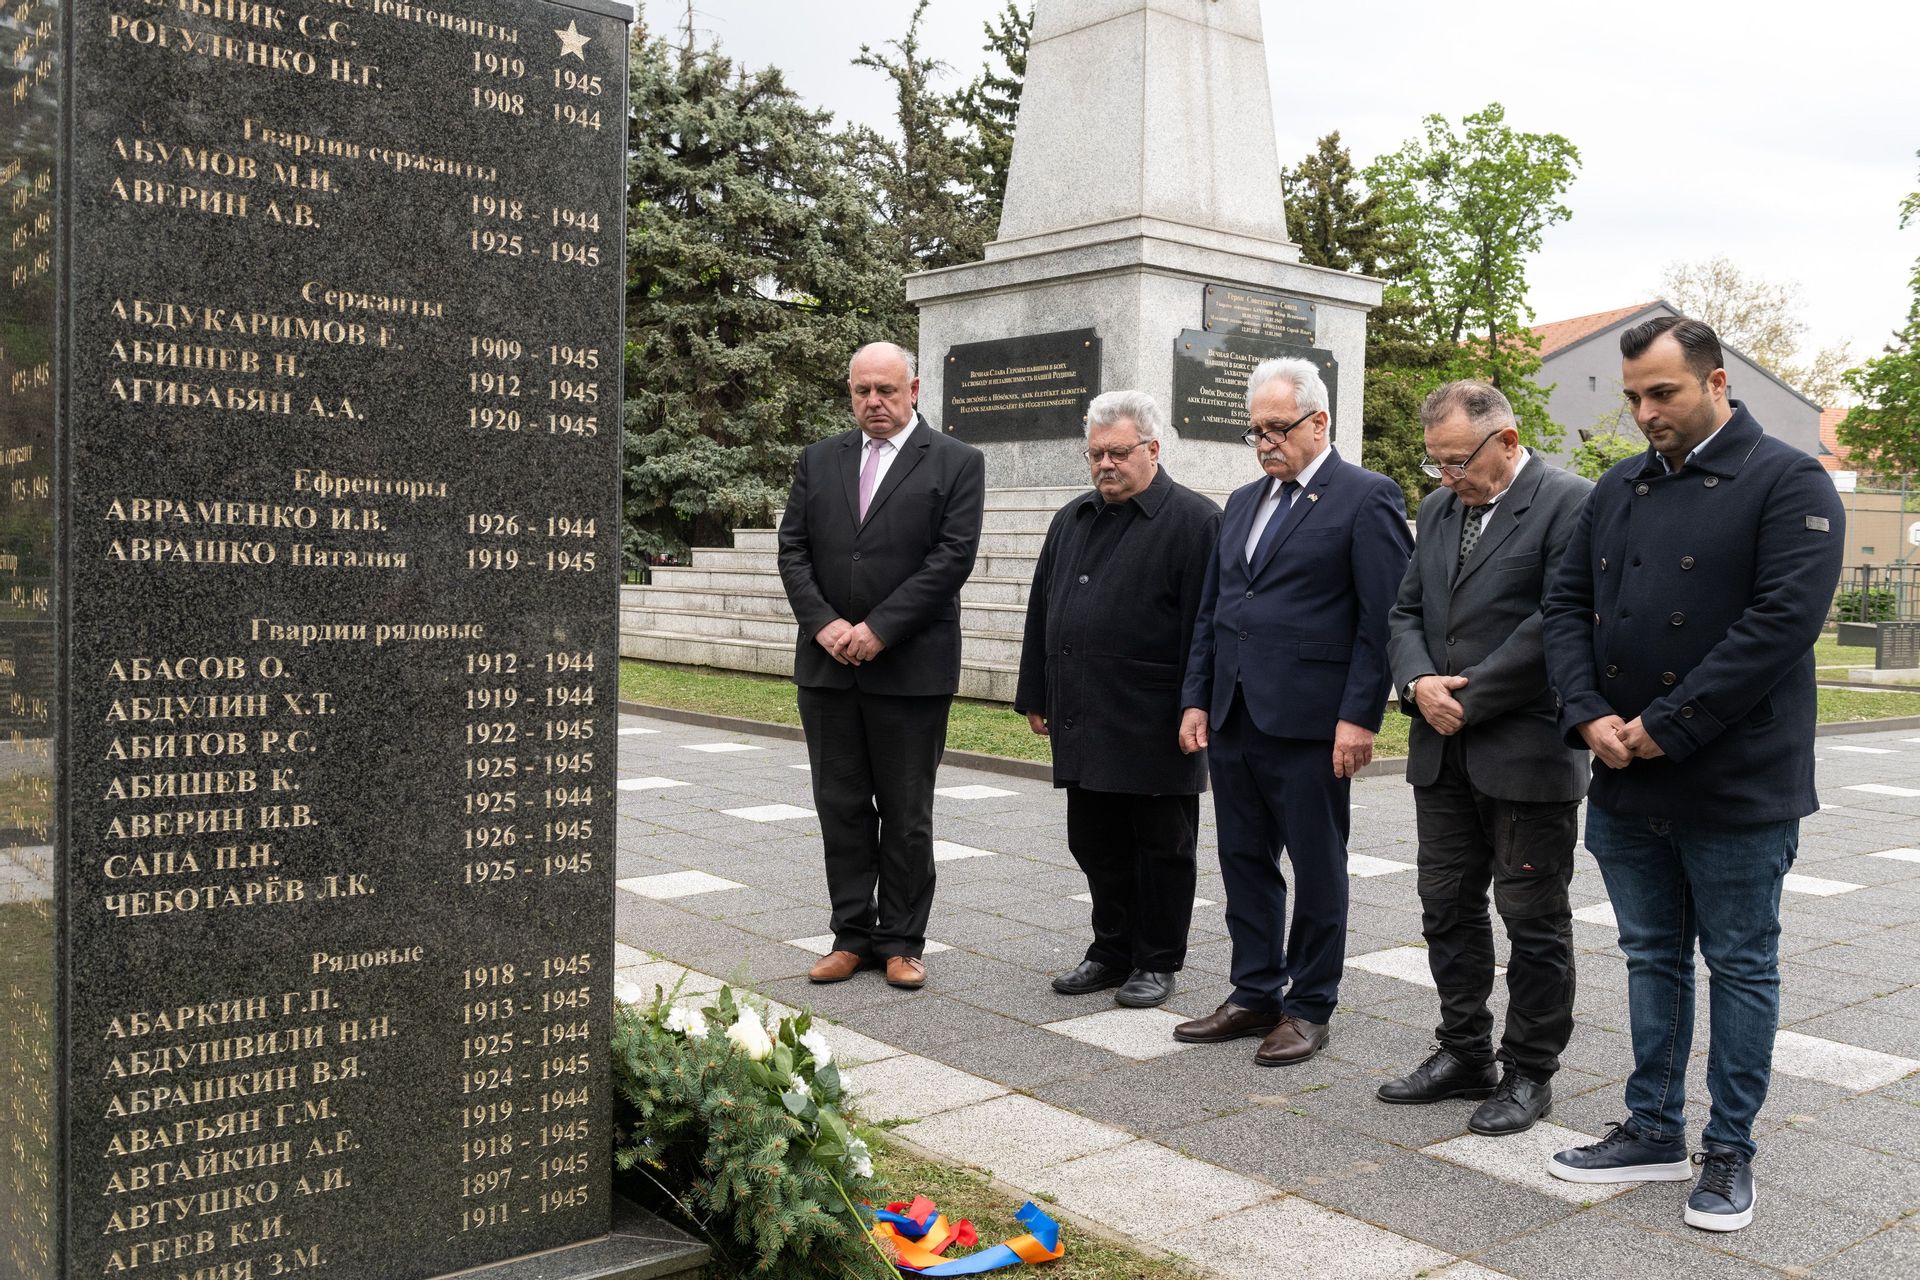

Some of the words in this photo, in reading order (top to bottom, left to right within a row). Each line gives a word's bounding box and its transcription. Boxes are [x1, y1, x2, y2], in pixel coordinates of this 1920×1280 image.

[299, 15, 357, 46] С.С.
[110, 15, 316, 75] РОГУЛЕНКО
[331, 58, 382, 88] Н.Г.
[473, 51, 525, 79] 1919
[553, 68, 601, 96] 1945
[472, 87, 524, 116] 1908
[553, 103, 601, 130] 1944
[113, 137, 257, 179] АБУМОВ
[272, 162, 339, 193] М.И.
[244, 118, 360, 159] Гвардии
[369, 147, 496, 182] сержанты
[110, 176, 247, 217] АВЕРИН
[266, 201, 320, 228] А.В.
[472, 194, 523, 221] 1918
[552, 207, 599, 232] 1944
[470, 229, 522, 256] 1925
[552, 241, 599, 267] 1945
[302, 281, 443, 317] Сержанты
[111, 299, 365, 346] АБДУКАРИМОВ
[380, 326, 404, 350] Е.
[109, 339, 260, 373] АБИШЕВ
[275, 353, 305, 378] Н.
[470, 336, 522, 360] 1909
[550, 345, 599, 370] 1945
[110, 377, 291, 415] АГИБАБЯН
[307, 395, 363, 420] А.А.
[469, 372, 521, 397] 1912
[549, 379, 598, 403] 1945
[469, 407, 521, 432] 1920
[548, 414, 598, 437] 1945
[104, 497, 317, 529] АВРАМЕНКО
[331, 508, 387, 531] И.В.
[467, 513, 520, 536] 1926
[547, 516, 596, 538] 1944
[104, 538, 276, 565] АВРАШКО
[291, 544, 407, 568] Наталия
[466, 549, 519, 570] 1919
[546, 551, 595, 572] 1945
[251, 618, 367, 647] Гвардии
[376, 623, 483, 646] рядовые
[106, 656, 246, 682] АБАСОВ
[259, 656, 291, 679] О.
[466, 652, 517, 674] 1912
[545, 651, 595, 672] 1944
[105, 694, 268, 724] АБДУЛИН
[283, 693, 336, 716] Х.Т.
[466, 688, 518, 709] 1919
[545, 686, 594, 707] 1944
[104, 732, 247, 760] АБИТОВ
[261, 730, 317, 754] Р.С.
[465, 722, 517, 745] 1922
[544, 719, 594, 742] 1945
[104, 770, 257, 800] АБИШЕВ
[271, 768, 300, 791] К.
[465, 757, 517, 780] 1925
[544, 753, 594, 775] 1945
[464, 792, 516, 815] 1925
[544, 786, 593, 809] 1944
[104, 807, 244, 840] АВЕРИН
[259, 804, 319, 829] И.В.
[464, 825, 516, 849] 1926
[543, 819, 593, 842] 1945
[103, 850, 201, 879] САПА
[215, 843, 280, 871] П.Н.
[464, 859, 516, 884] 1925
[543, 853, 592, 876] 1945
[104, 876, 305, 918] ЧЕБОТАРЁВ
[317, 873, 376, 900] Л.К.
[312, 944, 424, 975] Рядовые
[463, 963, 514, 990] 1918
[542, 953, 591, 980] 1945
[104, 996, 267, 1040] АБАРКИН
[282, 987, 339, 1016] Г.П.
[462, 998, 513, 1025] 1913
[542, 986, 591, 1013] 1945
[104, 1025, 324, 1080] АБДУШВИЛИ
[338, 1015, 398, 1044] Н.Н.
[462, 1032, 514, 1060] 1925
[541, 1020, 590, 1047] 1944
[104, 1064, 299, 1119] АБРАШКИН
[312, 1055, 367, 1085] В.Я.
[462, 1065, 513, 1094] 1924
[541, 1053, 590, 1081] 1945
[461, 1100, 513, 1128] 1919
[540, 1086, 589, 1114] 1944
[104, 1108, 261, 1159] АВАГЬЯН
[275, 1096, 338, 1128] Г.М.
[461, 1135, 513, 1163] 1918
[539, 1119, 589, 1147] 1945
[102, 1139, 292, 1197] АВТАЙКИН
[305, 1129, 361, 1159] А.Е.
[460, 1168, 513, 1197] 1897
[539, 1151, 588, 1181] 1945
[103, 1180, 279, 1235] АВТУШКО
[293, 1166, 351, 1198] А.И.
[460, 1203, 510, 1232] 1911
[538, 1184, 588, 1214] 1945
[103, 1230, 215, 1275] АГЕЕВ
[230, 1214, 291, 1248] К.И.
[268, 1243, 327, 1276] З.М.
